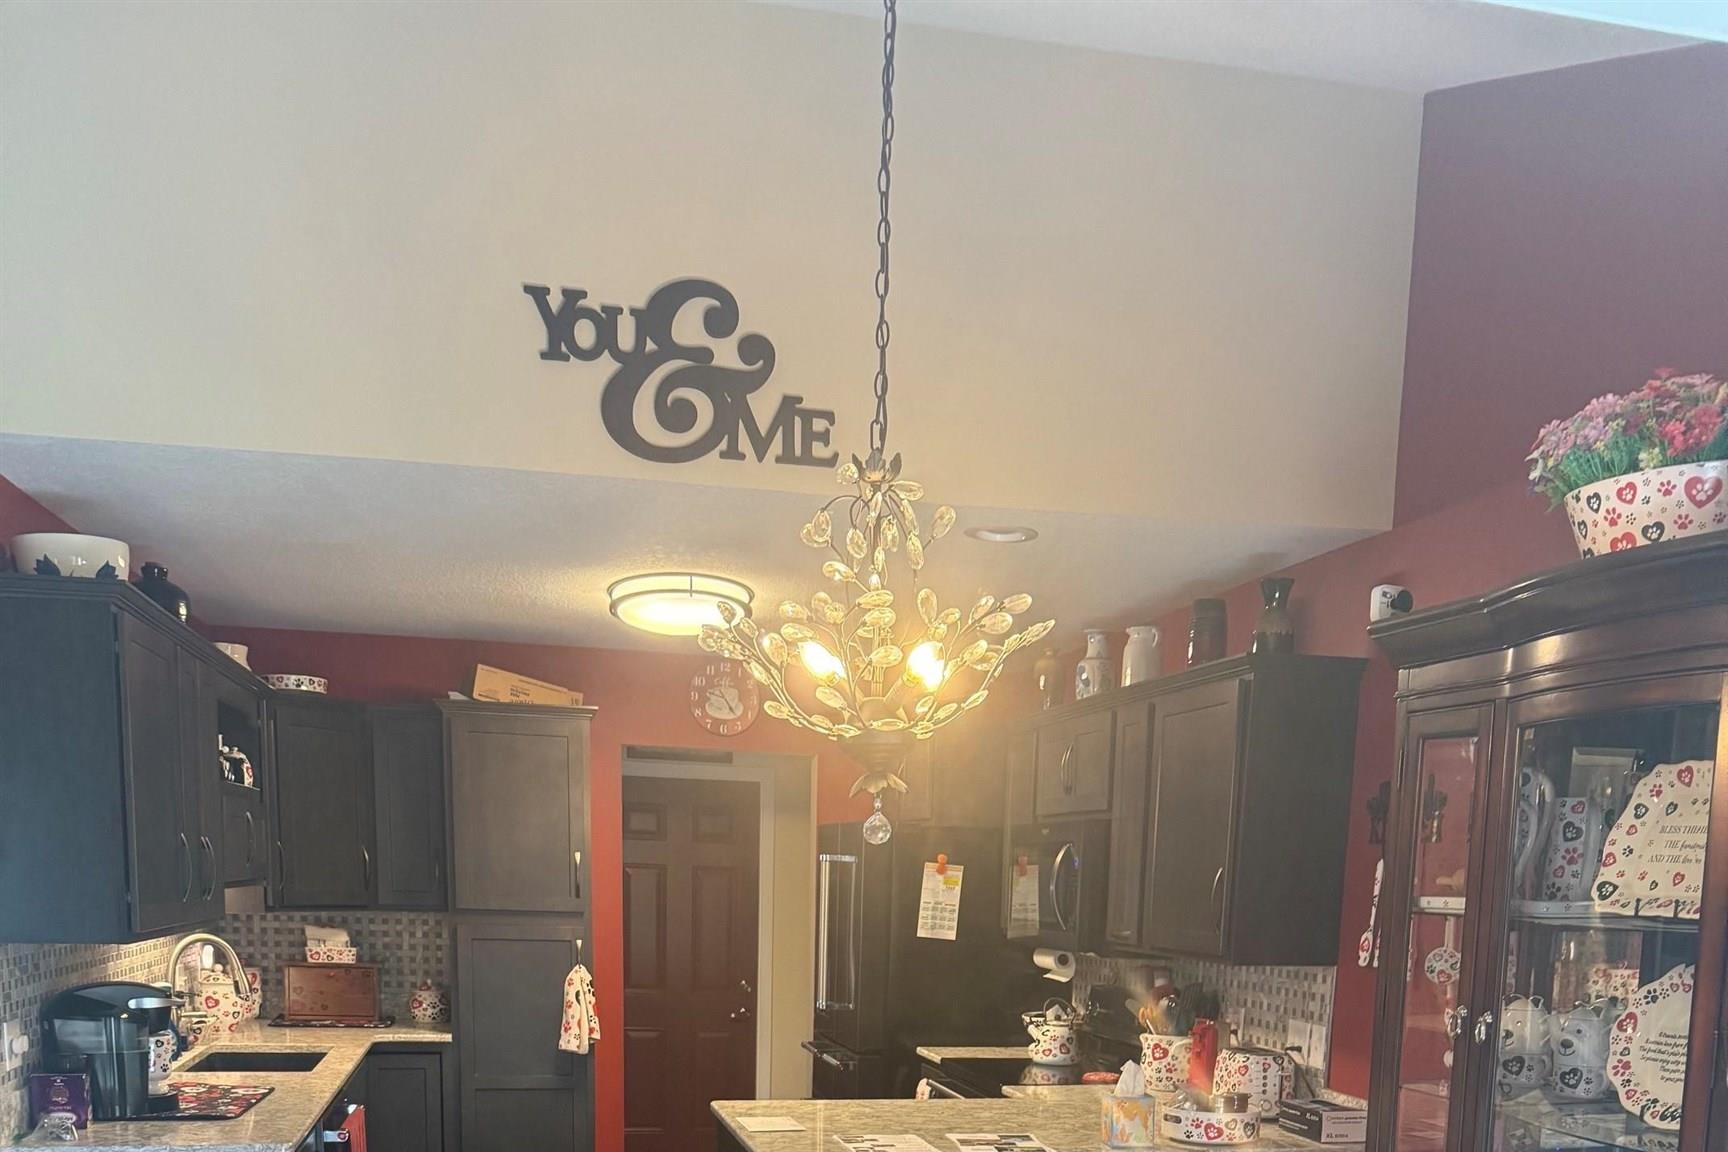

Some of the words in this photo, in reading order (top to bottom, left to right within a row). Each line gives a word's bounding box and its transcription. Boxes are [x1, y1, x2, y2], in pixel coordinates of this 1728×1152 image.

[601, 279, 776, 464] &
[718, 393, 840, 468] ME
[706, 664, 715, 676] 11
[695, 676, 706, 686] 10
[1664, 839, 1681, 849] THE
[1648, 854, 1665, 863] AND
[1665, 854, 1681, 864] THE
